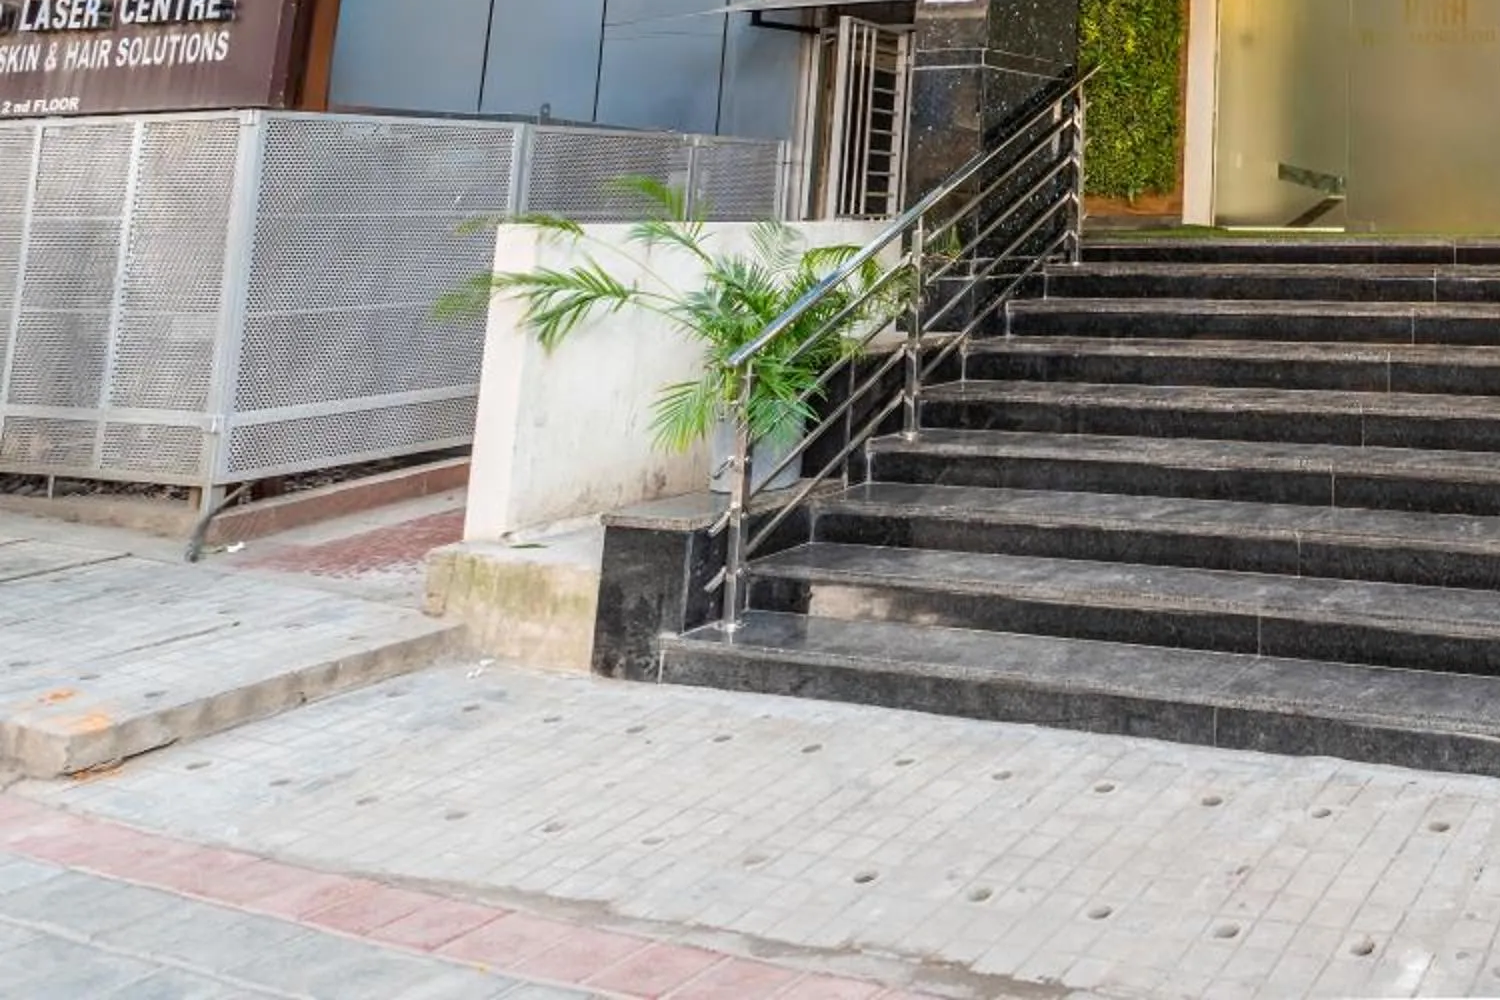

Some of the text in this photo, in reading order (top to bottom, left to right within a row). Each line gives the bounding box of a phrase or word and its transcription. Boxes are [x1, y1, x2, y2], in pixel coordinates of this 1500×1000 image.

[0, 31, 229, 73] SKIN & HAIR SOLUTIONS
[33, 97, 80, 113] FLOOR
